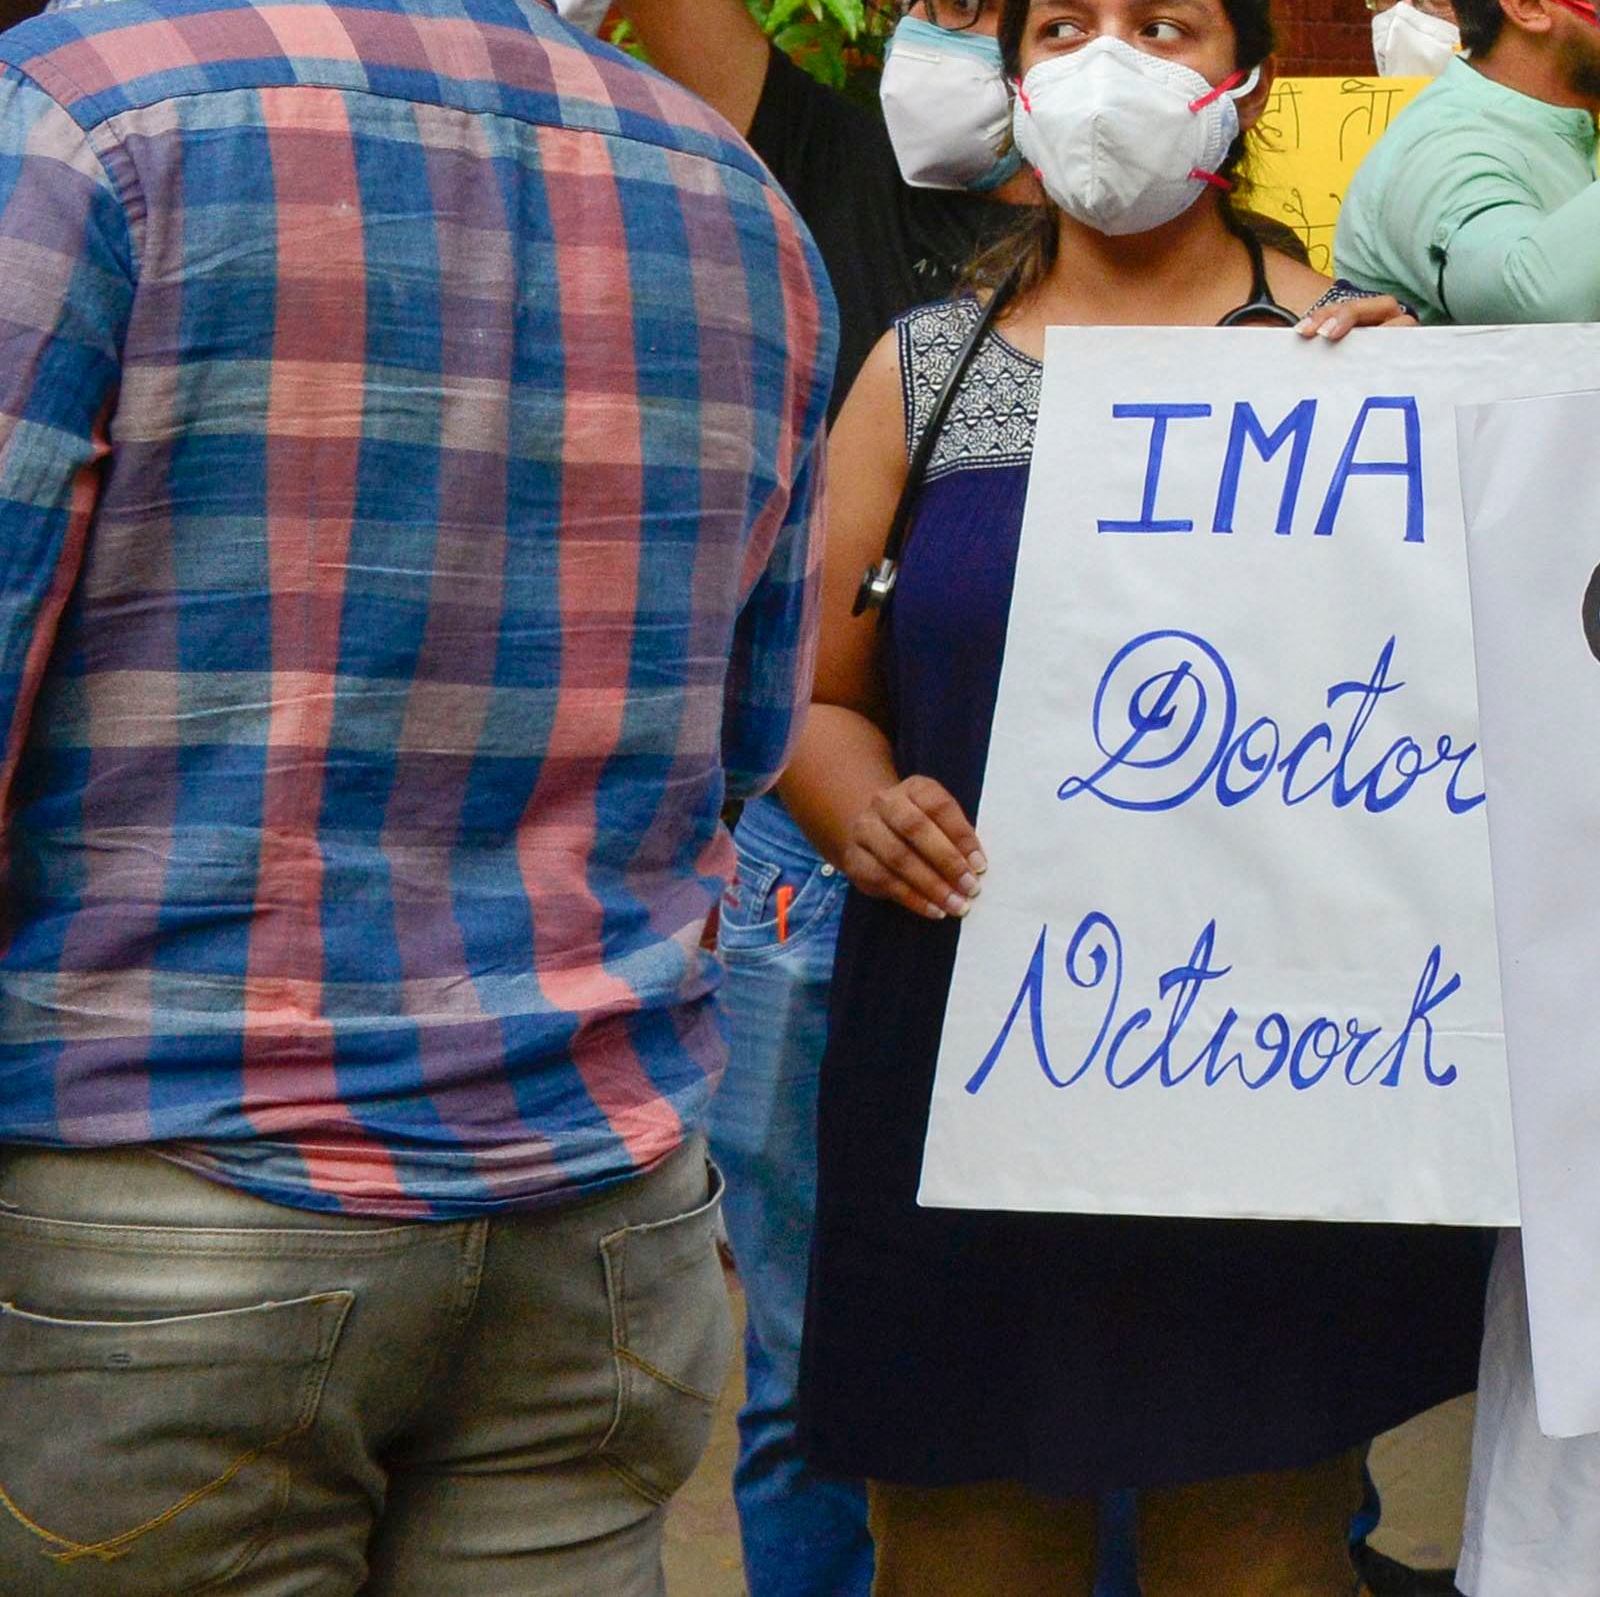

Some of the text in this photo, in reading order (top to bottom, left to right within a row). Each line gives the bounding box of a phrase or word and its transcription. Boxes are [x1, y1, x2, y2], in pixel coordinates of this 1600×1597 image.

[1096, 394, 1427, 544] IMA
[1056, 628, 1487, 815] Doctor
[964, 910, 1463, 1096] Network
